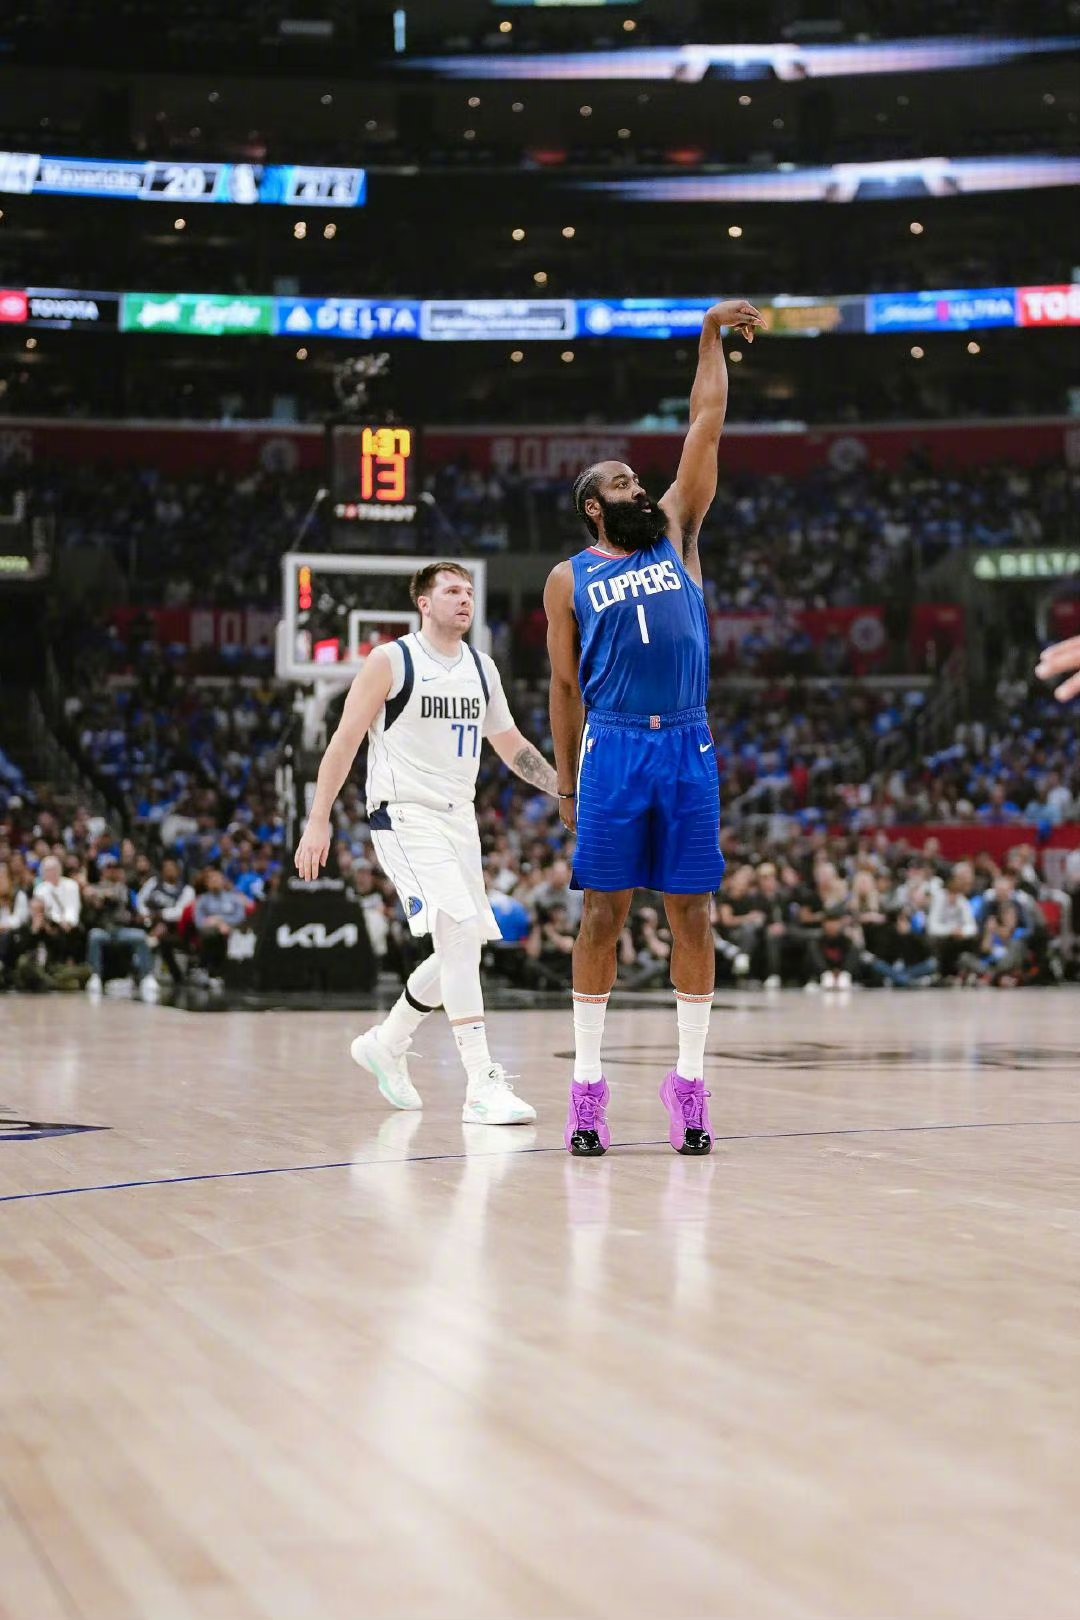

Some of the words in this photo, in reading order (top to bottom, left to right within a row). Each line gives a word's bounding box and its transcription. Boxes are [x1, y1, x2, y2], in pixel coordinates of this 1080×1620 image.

[163, 166, 207, 197] 20
[30, 299, 99, 320] TOYOTA
[316, 305, 416, 332] DELTA
[361, 454, 406, 501] 13
[587, 560, 682, 613] CLIPPERS
[637, 604, 650, 644] 1
[420, 695, 481, 719] DALLAS
[451, 724, 478, 758] 77
